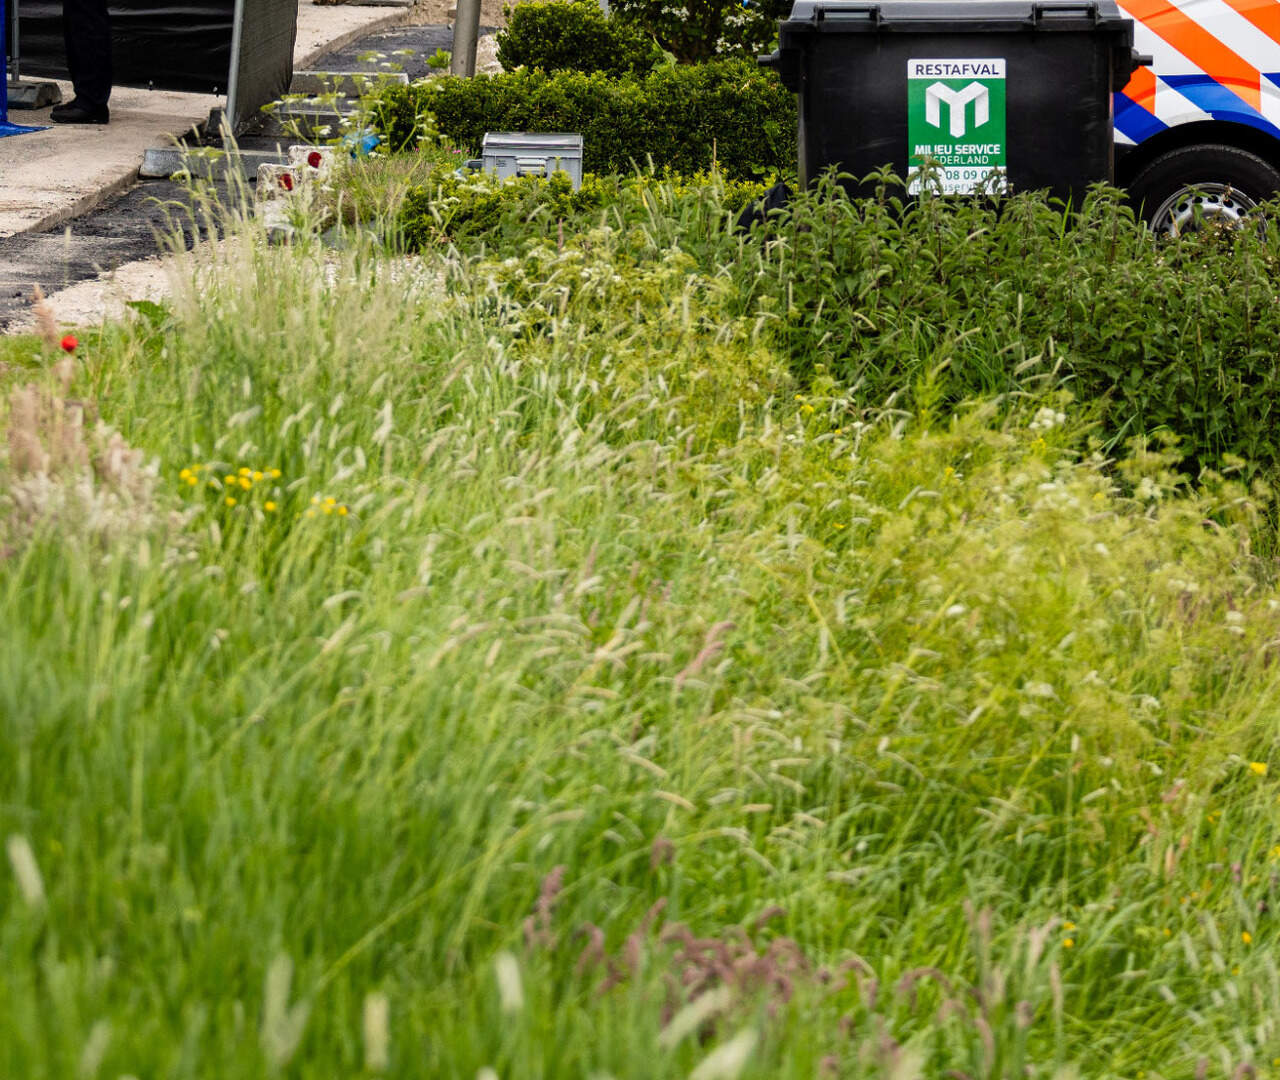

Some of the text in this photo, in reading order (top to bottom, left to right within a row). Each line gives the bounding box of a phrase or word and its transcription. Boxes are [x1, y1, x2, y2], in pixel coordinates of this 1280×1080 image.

[915, 63, 1000, 76] RESTAFVAL
[914, 143, 1001, 155] MILIEU SERVICE
[945, 169, 960, 180] 08
[963, 169, 977, 180] 09
